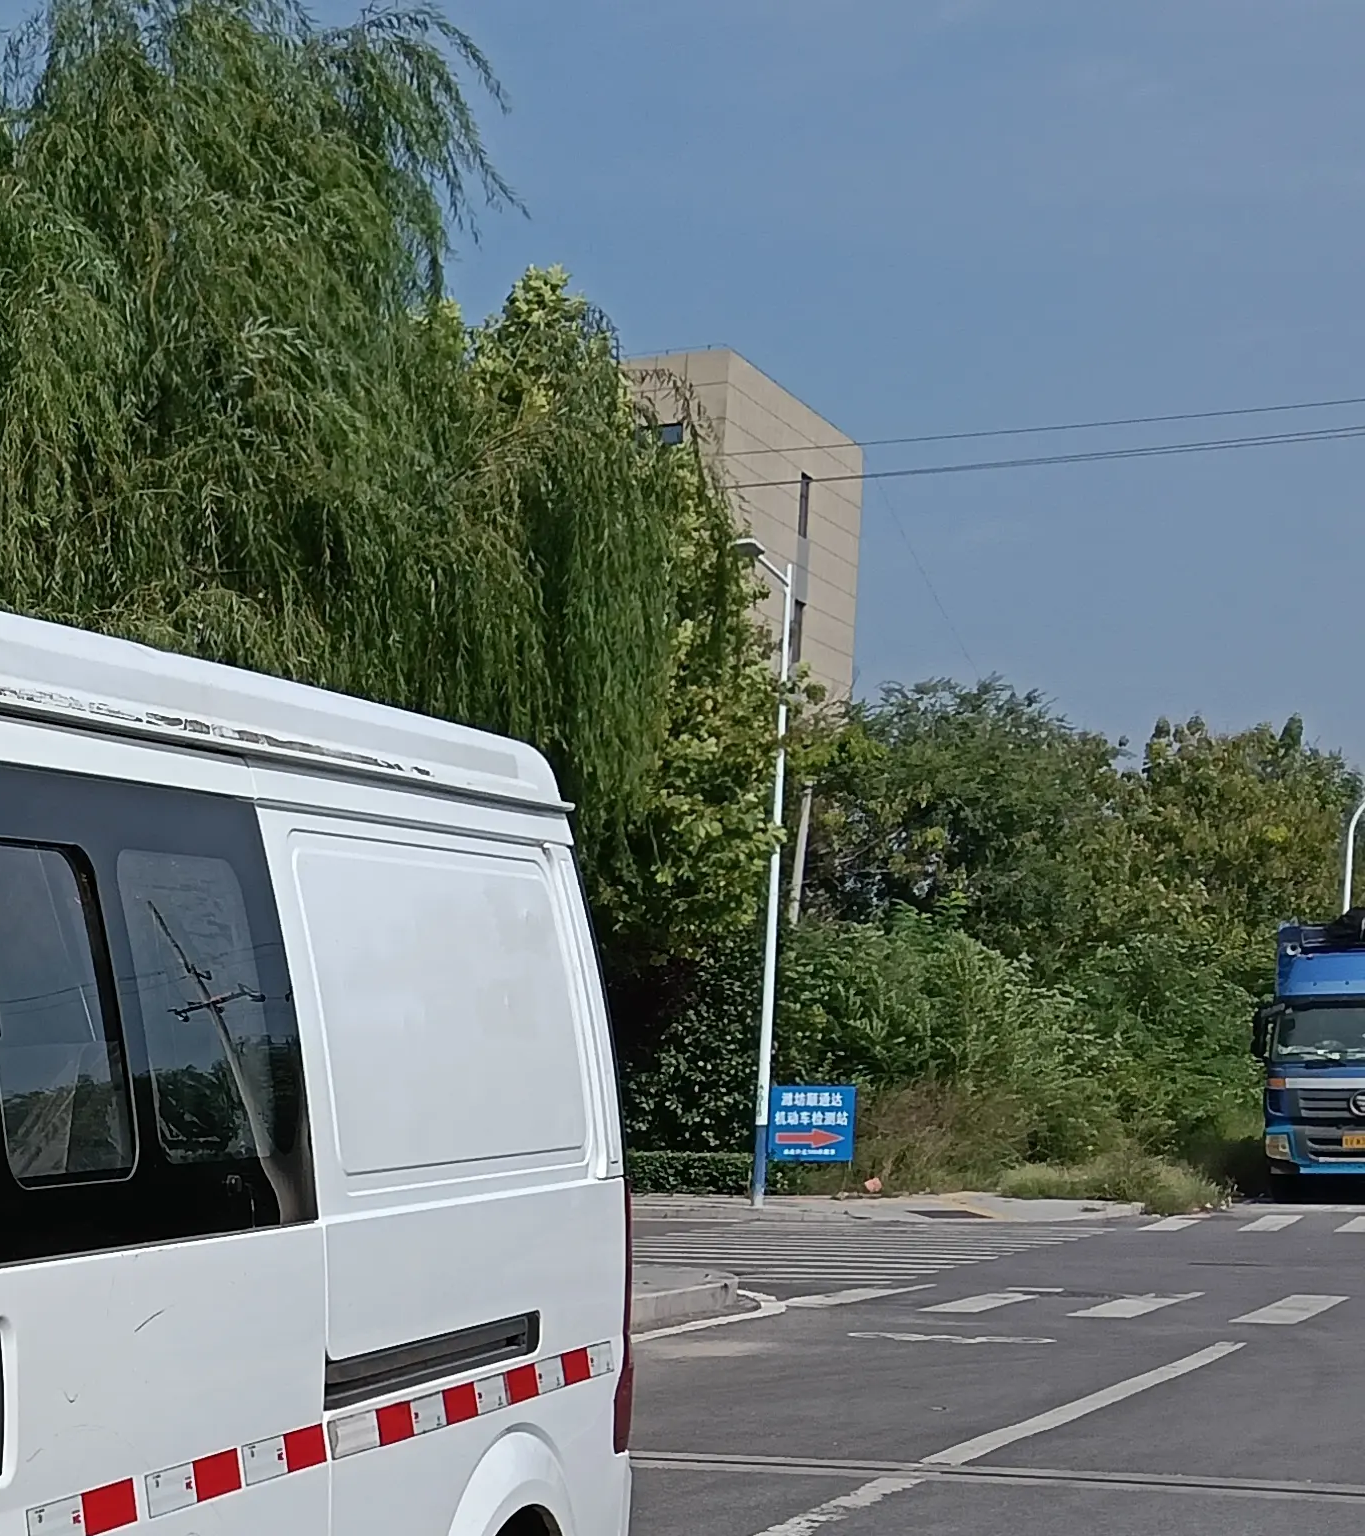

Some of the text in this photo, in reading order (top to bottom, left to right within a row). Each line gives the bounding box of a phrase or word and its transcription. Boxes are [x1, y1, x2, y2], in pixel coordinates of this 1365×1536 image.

[774, 1110, 849, 1126] 机动车检测站
